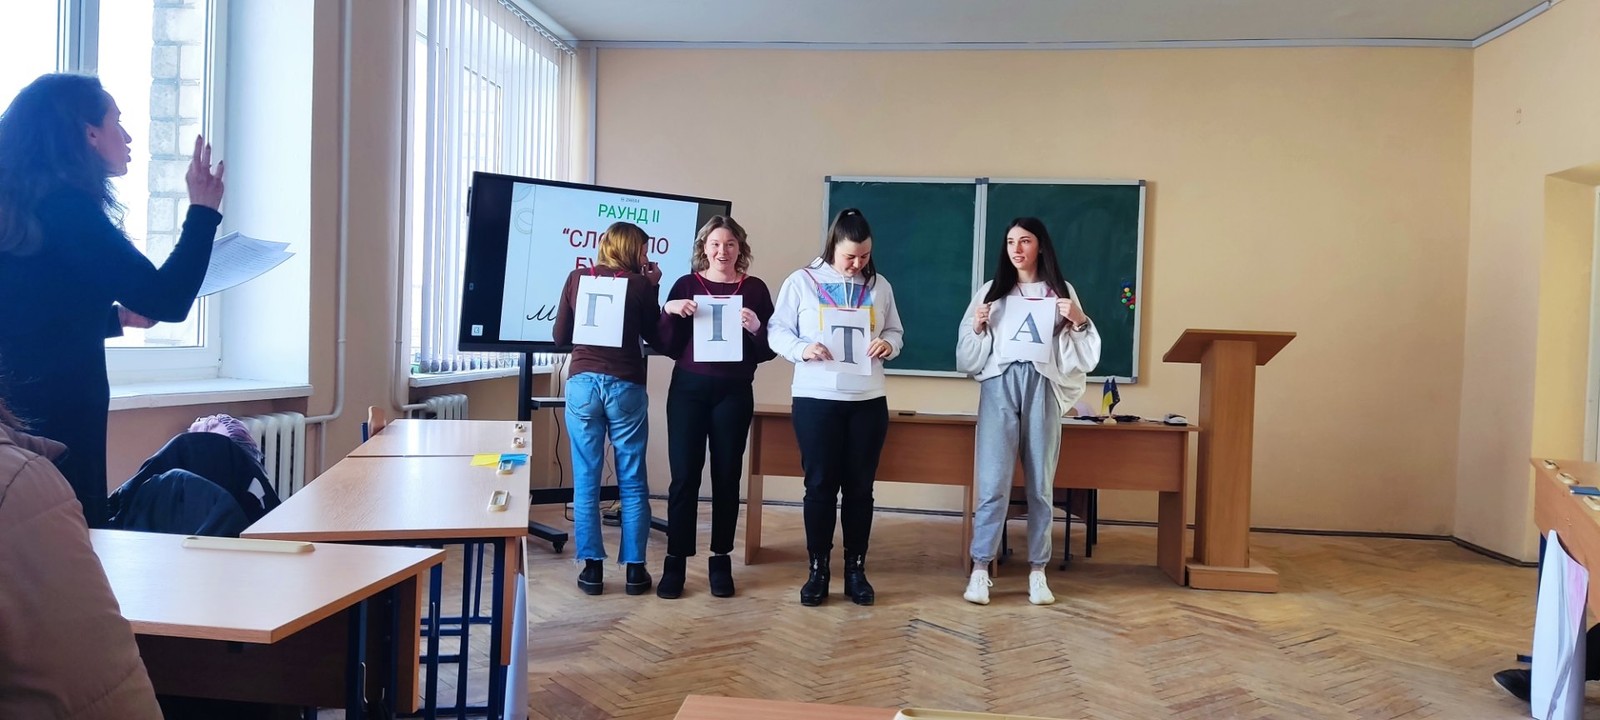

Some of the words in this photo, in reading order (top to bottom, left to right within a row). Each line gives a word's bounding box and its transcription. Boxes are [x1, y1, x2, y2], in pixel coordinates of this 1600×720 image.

[598, 203, 648, 225] РАУНД
[581, 292, 614, 328] Г
[831, 325, 865, 365] Т
[1009, 311, 1045, 345] А
